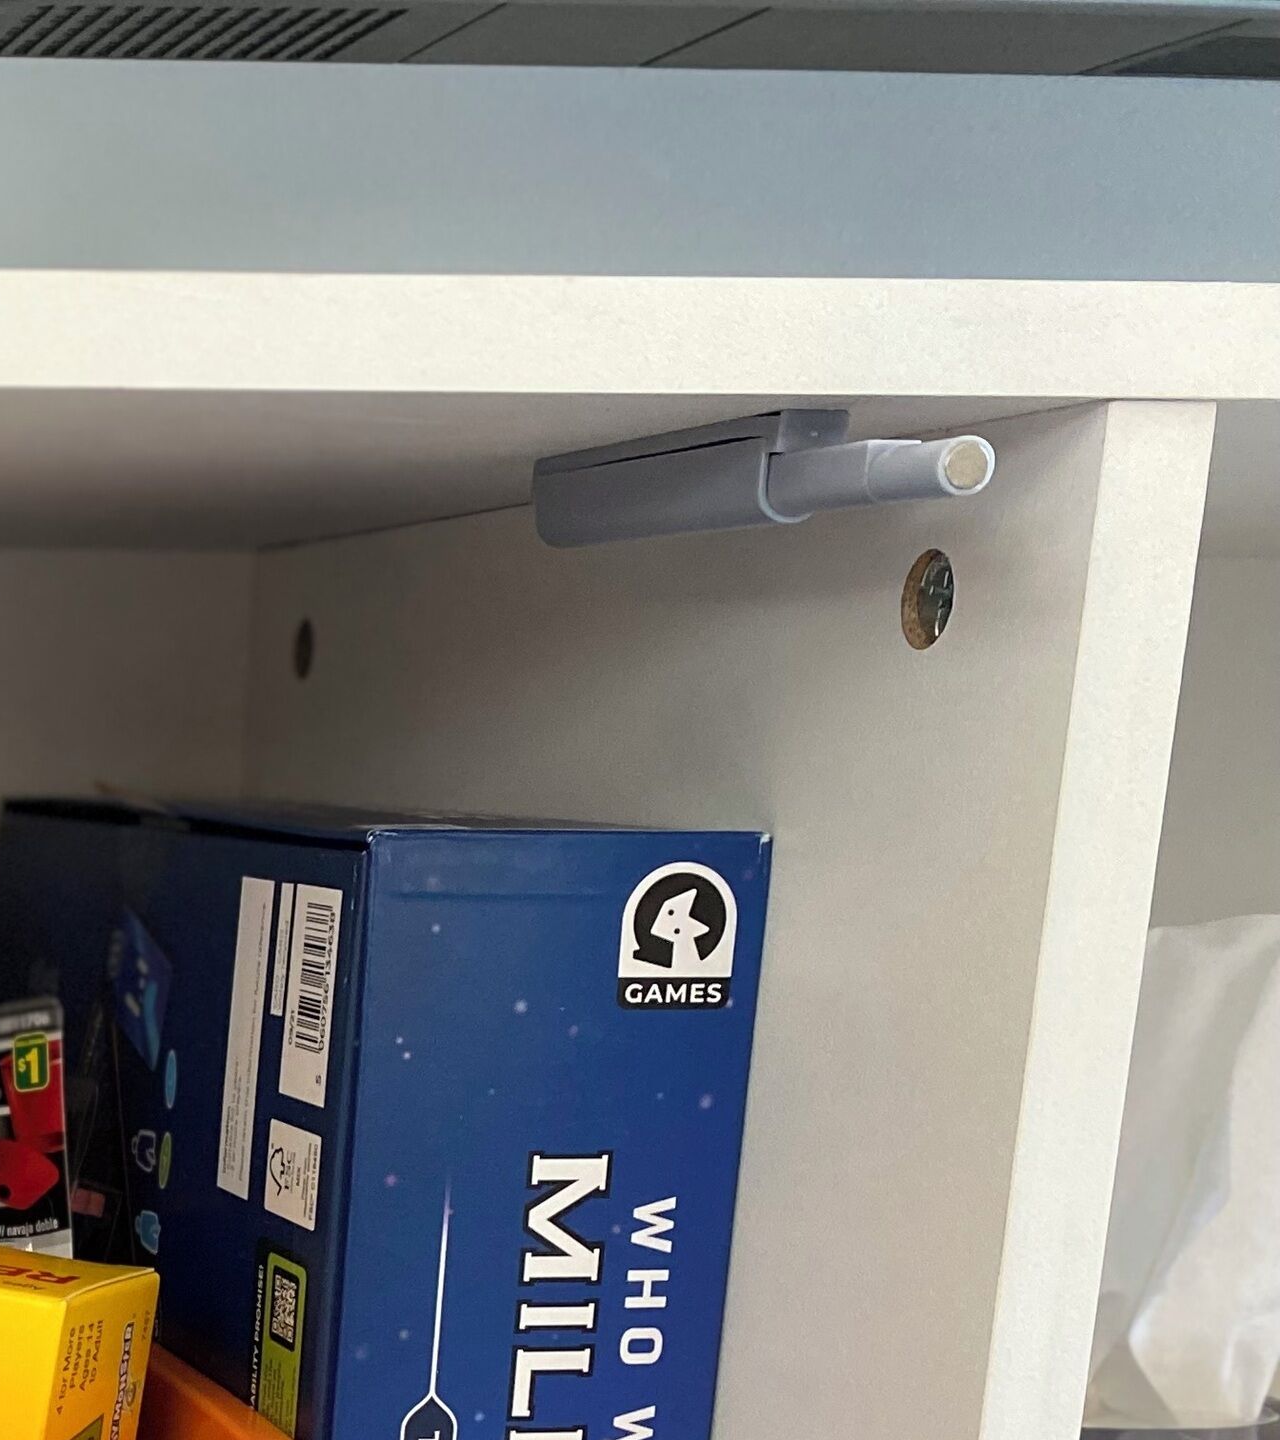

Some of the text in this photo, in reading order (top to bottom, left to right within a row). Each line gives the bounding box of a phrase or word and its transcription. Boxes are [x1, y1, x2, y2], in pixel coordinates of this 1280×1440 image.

[624, 982, 723, 1004] GAMES
[18, 1047, 39, 1083] $1
[618, 1196, 678, 1366] WHO
[63, 1327, 76, 1372] More
[70, 1324, 85, 1389] Players
[92, 1319, 104, 1363] Adult
[79, 1348, 91, 1391] Ages
